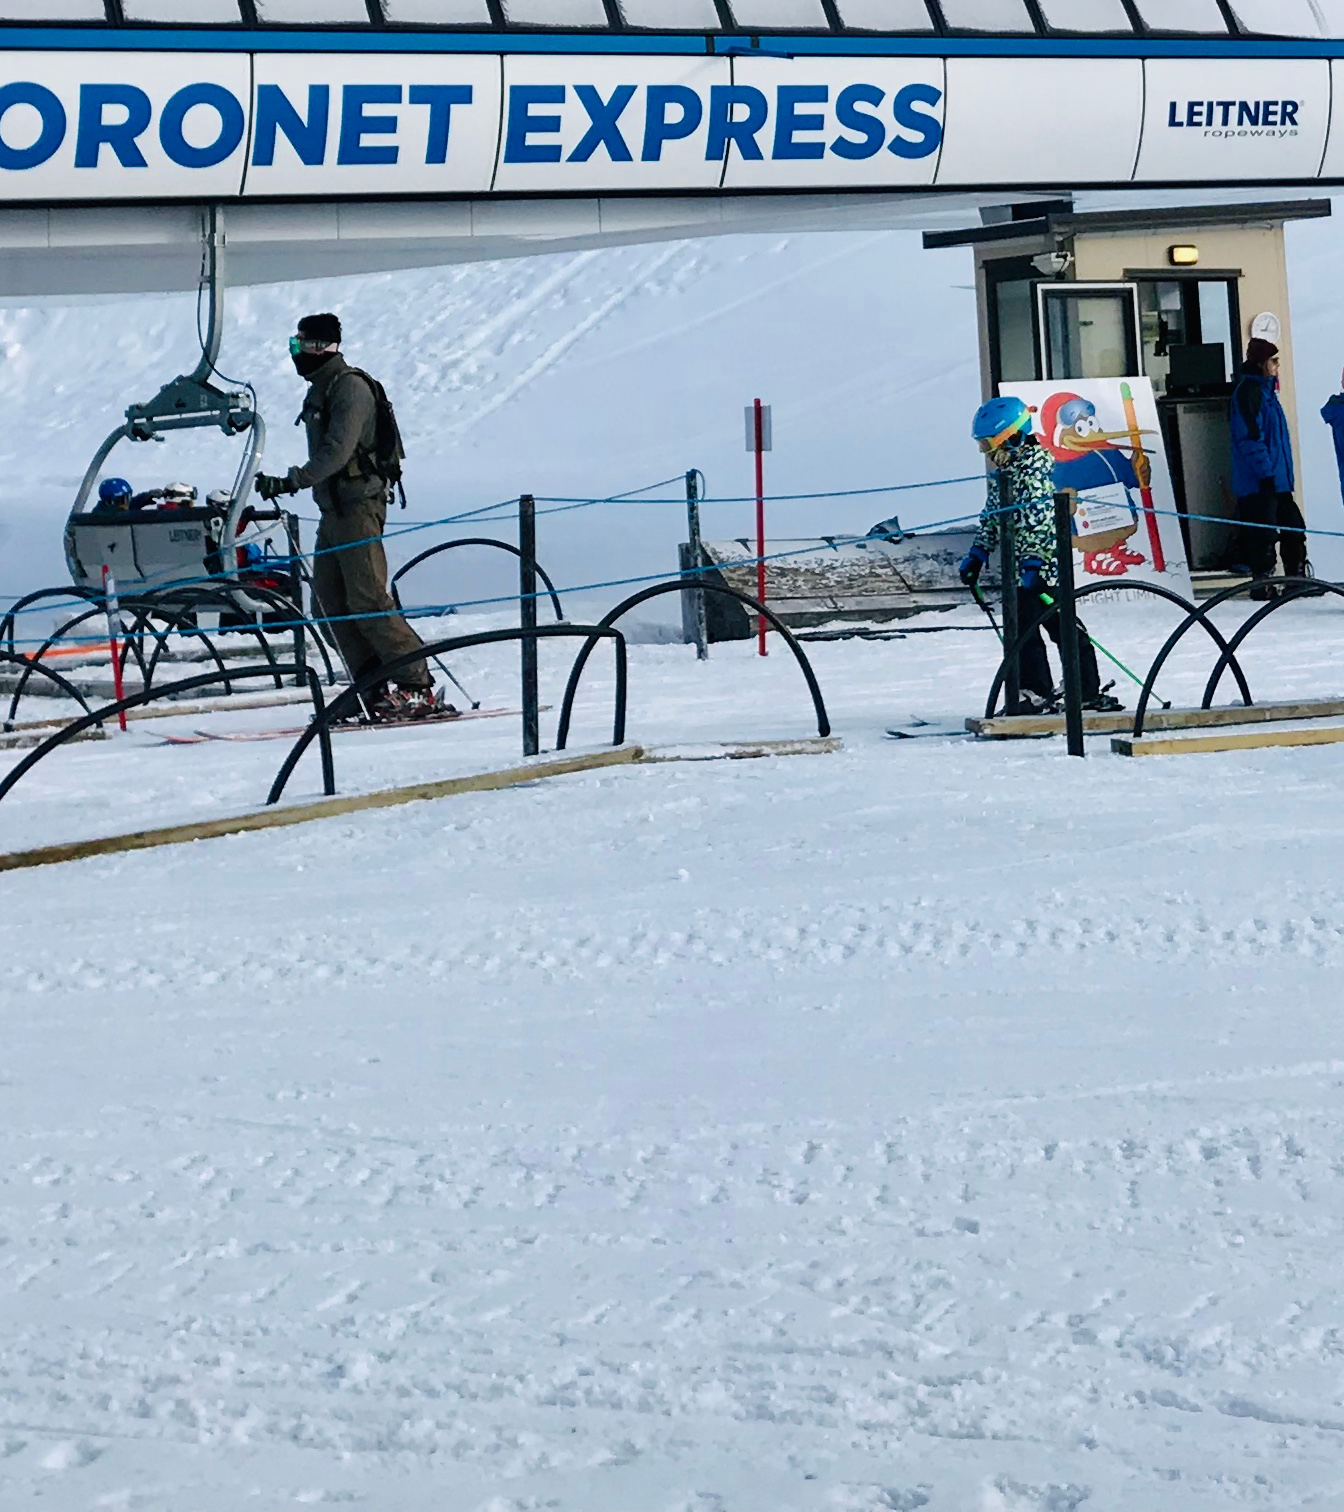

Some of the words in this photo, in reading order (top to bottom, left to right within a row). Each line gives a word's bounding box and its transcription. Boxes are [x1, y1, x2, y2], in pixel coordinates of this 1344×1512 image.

[503, 83, 944, 164] EXPRESS
[1167, 100, 1299, 127] LEITNER
[1203, 129, 1299, 139] ropeways
